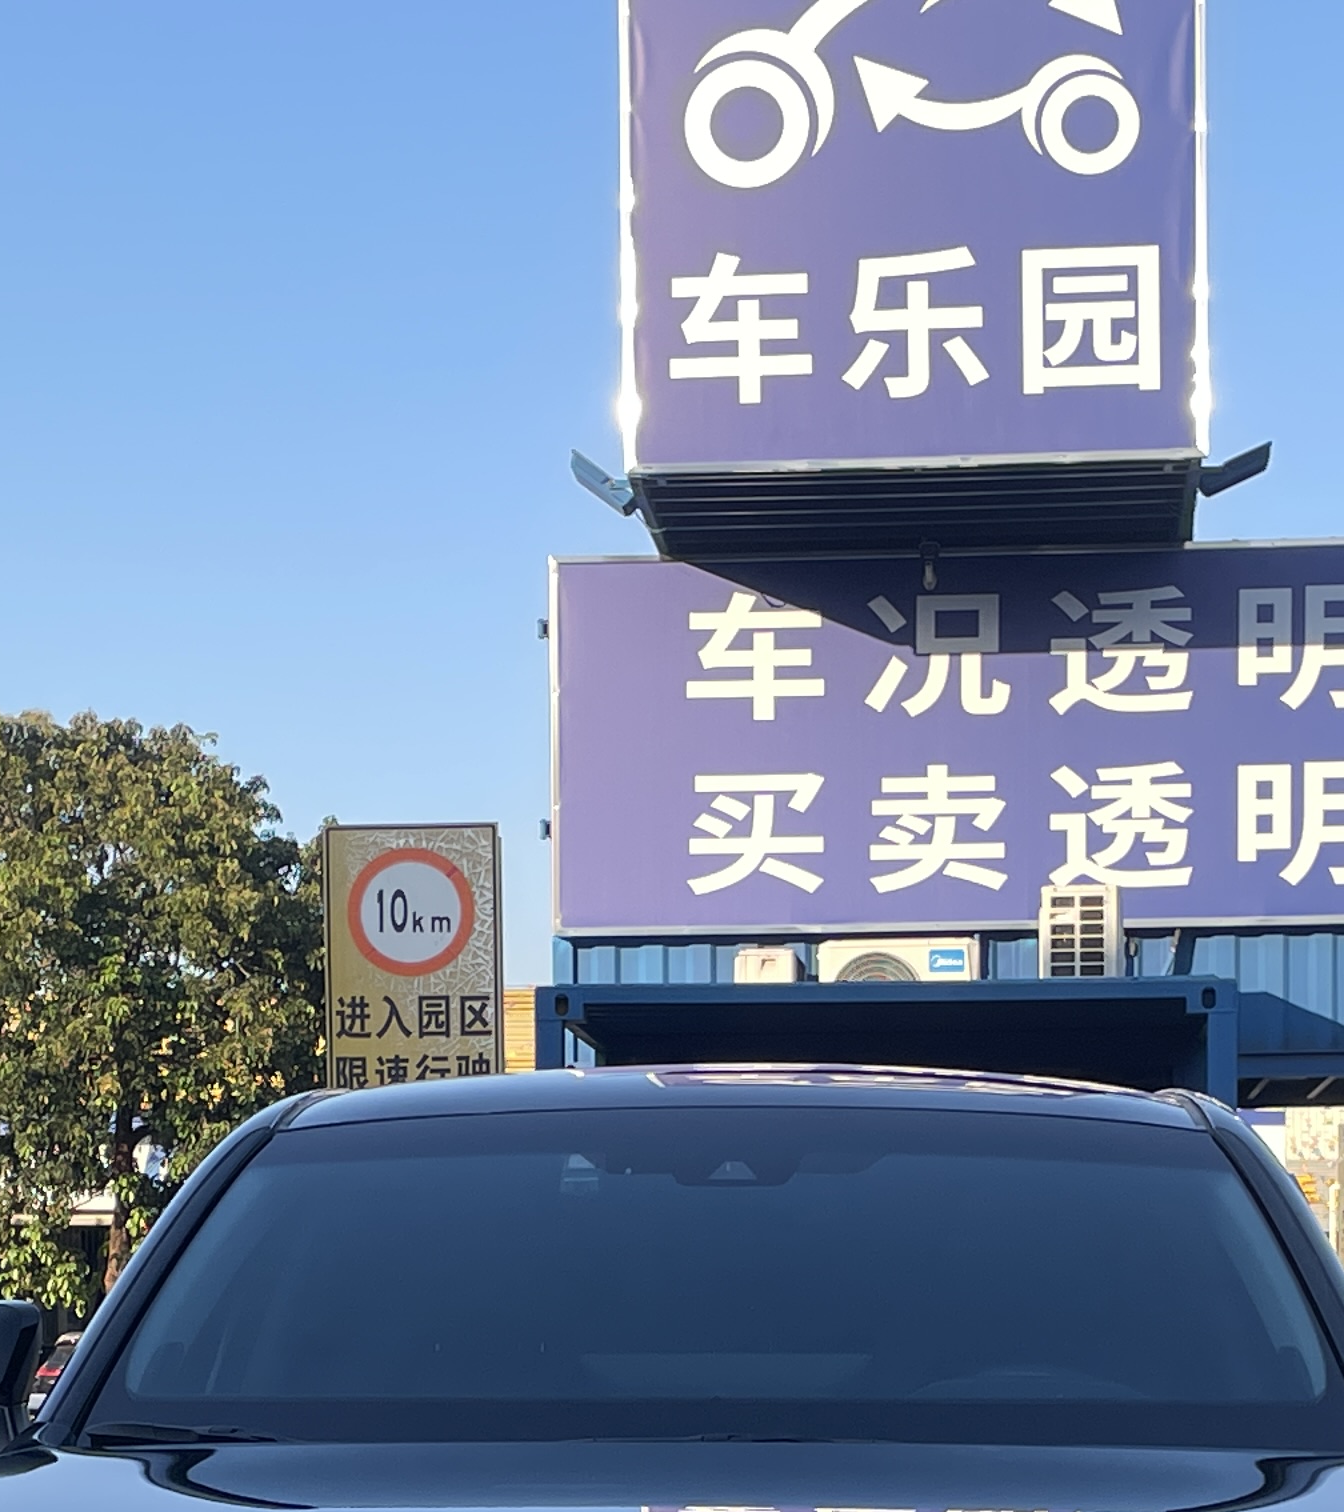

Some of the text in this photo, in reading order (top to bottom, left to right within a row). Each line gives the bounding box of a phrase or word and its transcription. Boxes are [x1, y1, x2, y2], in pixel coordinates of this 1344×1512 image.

[669, 244, 1160, 405] 车乐园
[335, 995, 493, 1039] 进入园区
